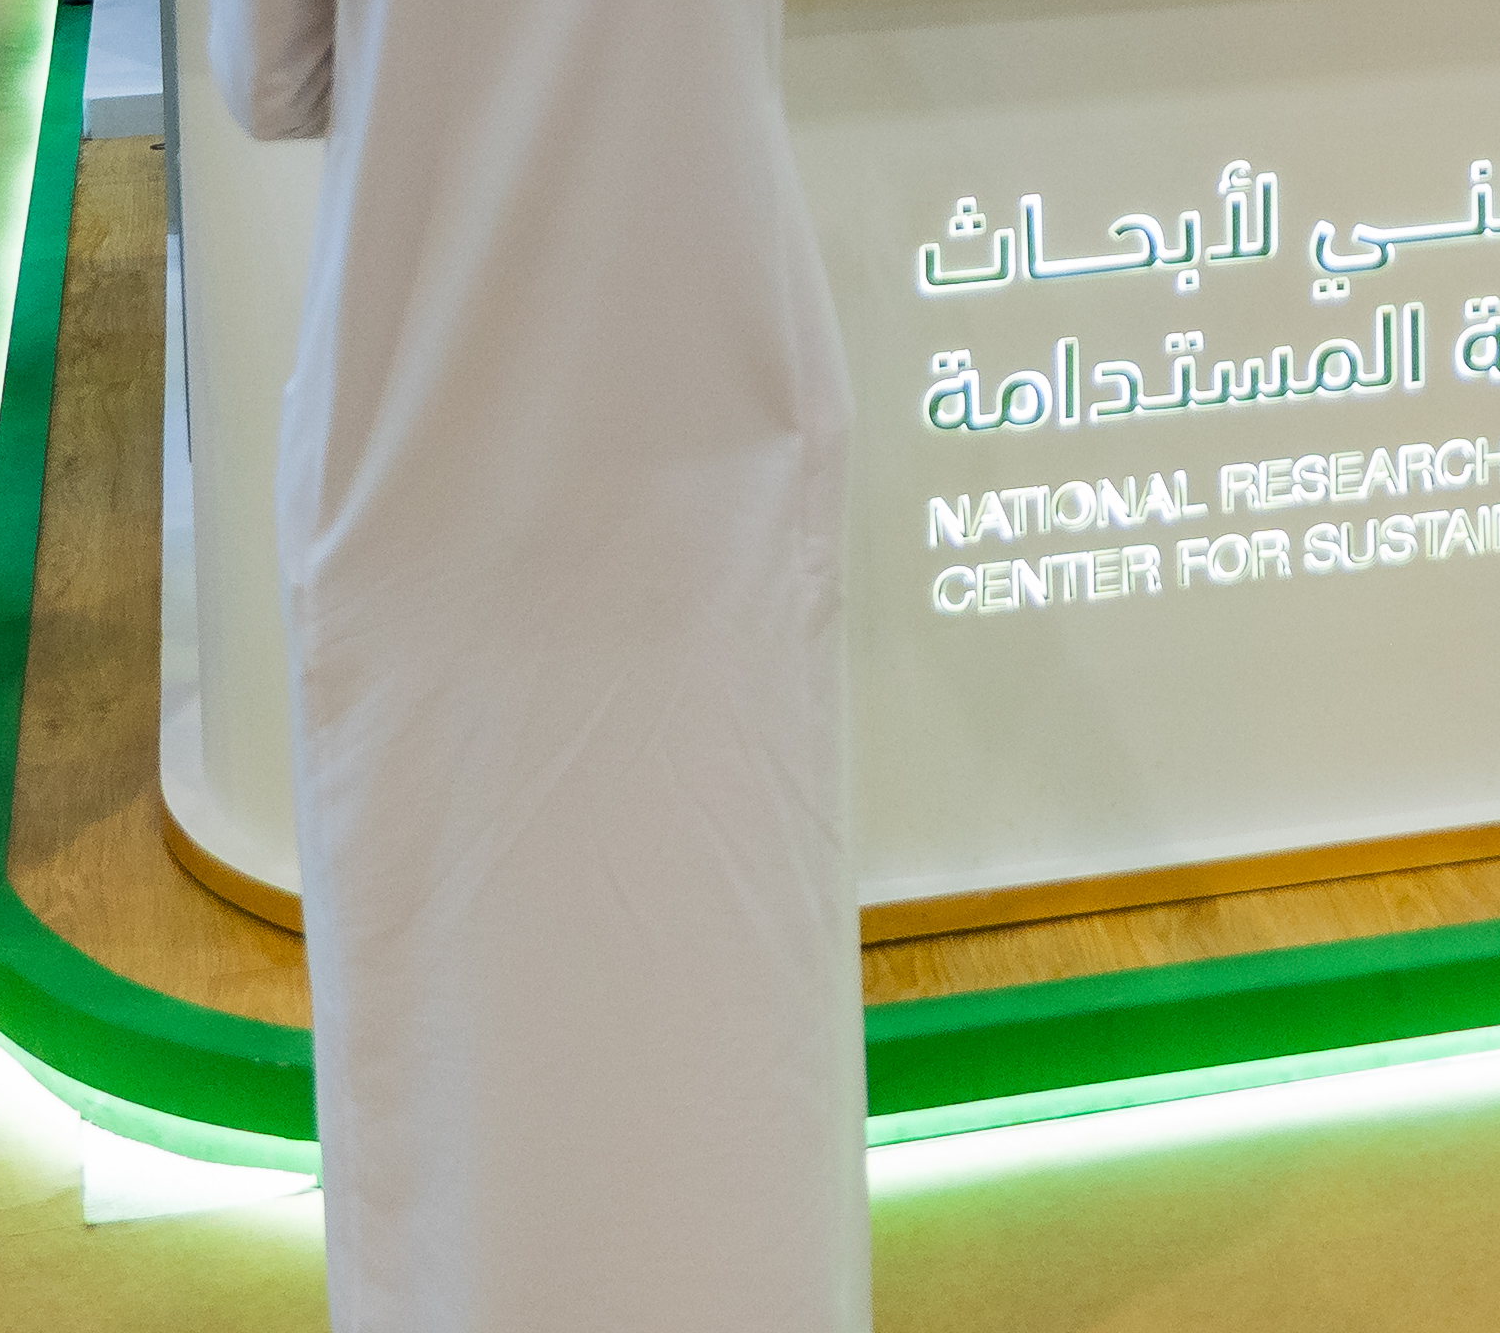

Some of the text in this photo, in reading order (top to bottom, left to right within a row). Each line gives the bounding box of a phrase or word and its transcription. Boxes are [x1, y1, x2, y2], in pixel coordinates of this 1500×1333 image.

[918, 159, 1278, 295] لأبحاث
[922, 301, 1425, 432] المستدامة
[929, 470, 1208, 548] NATIONAL
[934, 543, 1162, 614] CENTER
[1177, 530, 1292, 589] FOR
